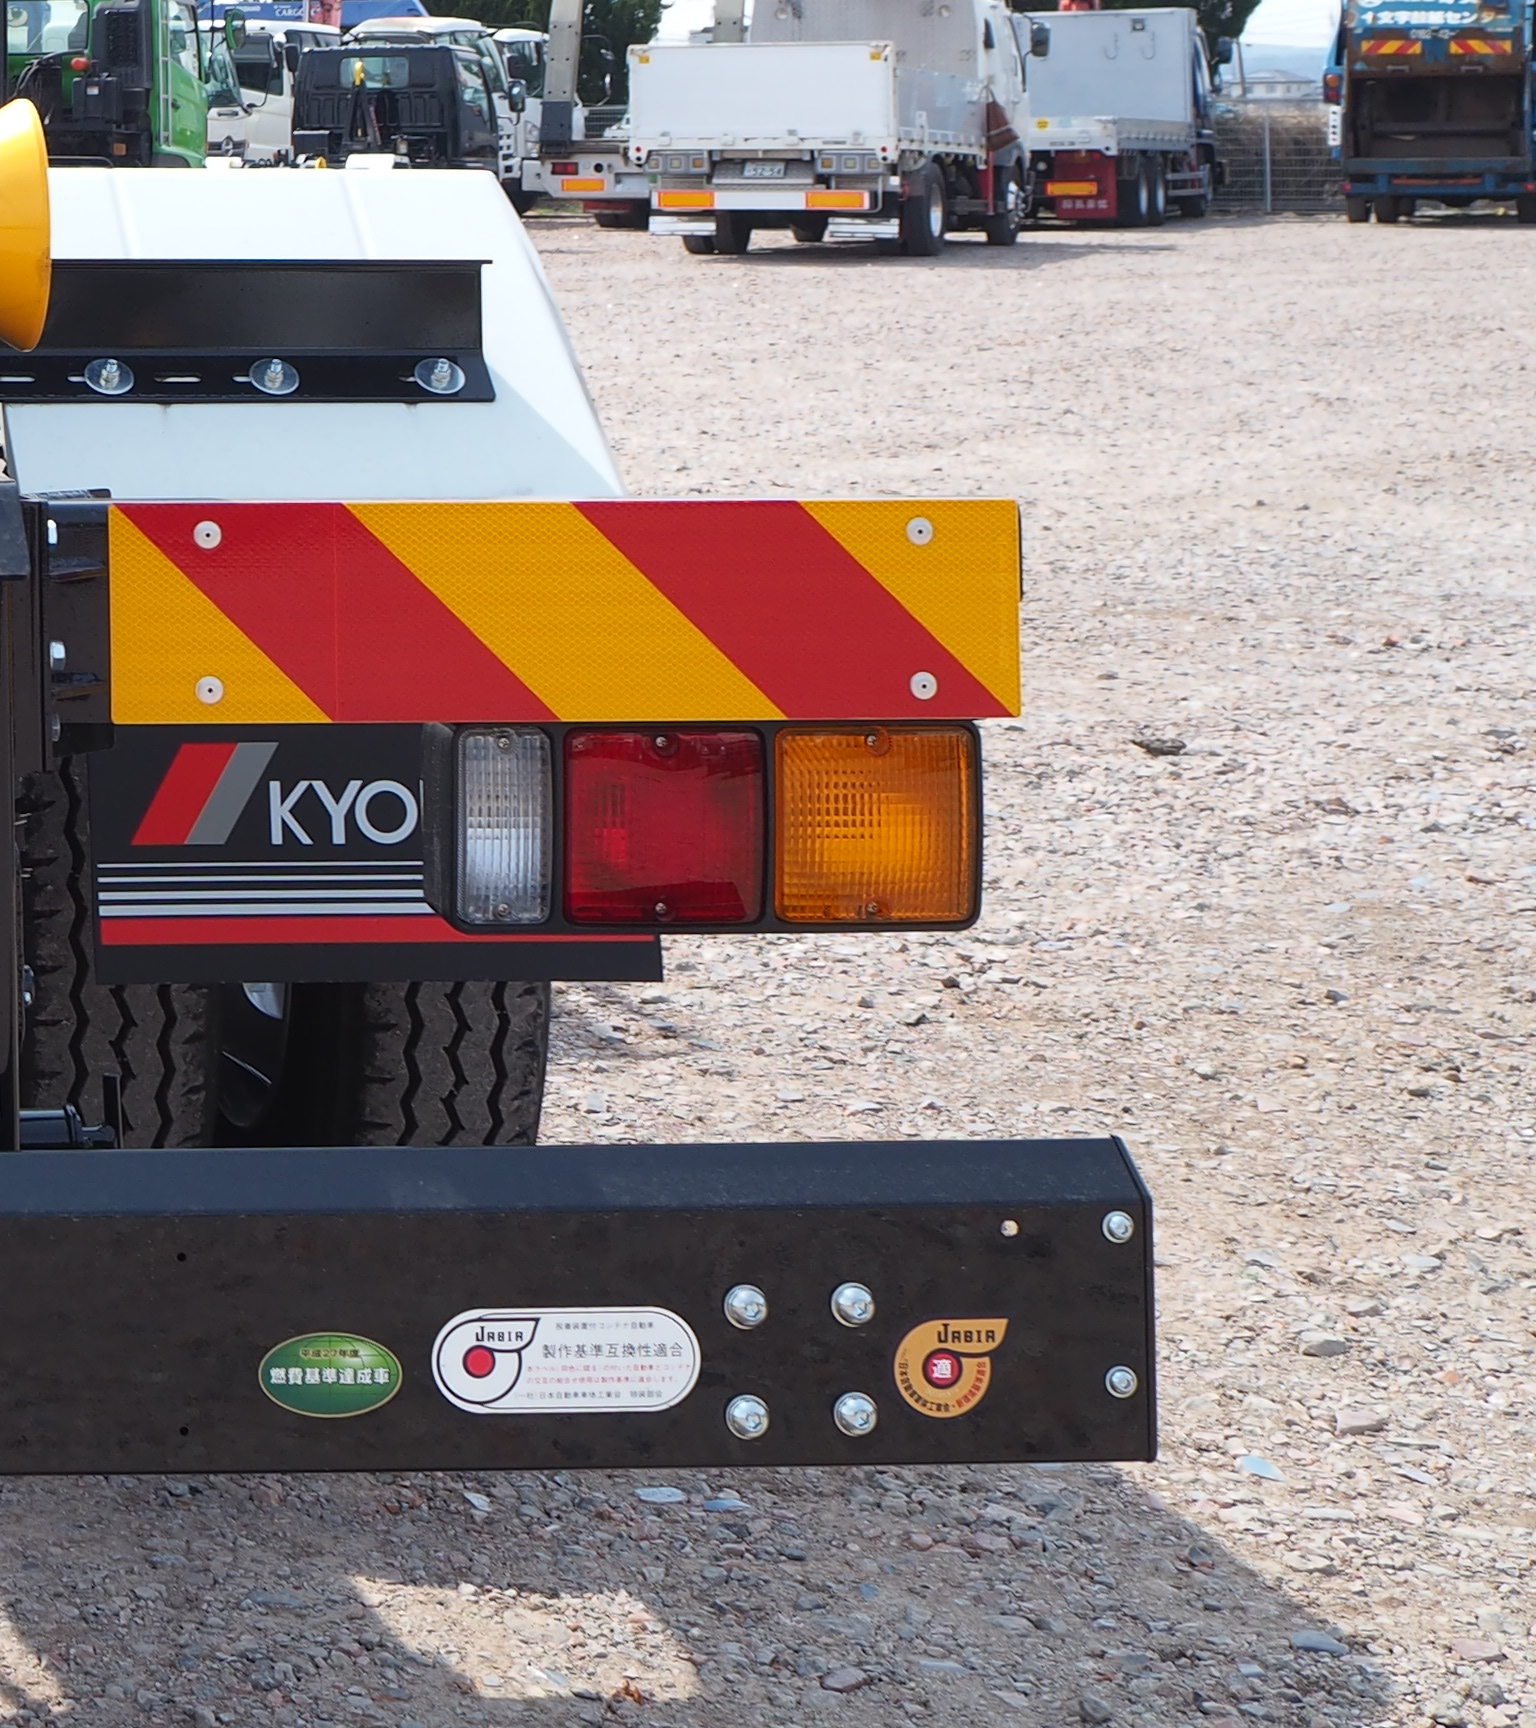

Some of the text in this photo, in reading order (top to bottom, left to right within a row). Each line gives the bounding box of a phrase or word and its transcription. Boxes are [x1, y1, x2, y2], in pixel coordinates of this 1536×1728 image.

[269, 779, 424, 845] KYO
[475, 1325, 525, 1342] JABIA
[937, 1323, 996, 1343] JABIA
[541, 1342, 684, 1360] 製作基準互換性適合
[269, 1367, 391, 1385] 燃費基準達成車
[932, 1358, 953, 1379] 適
